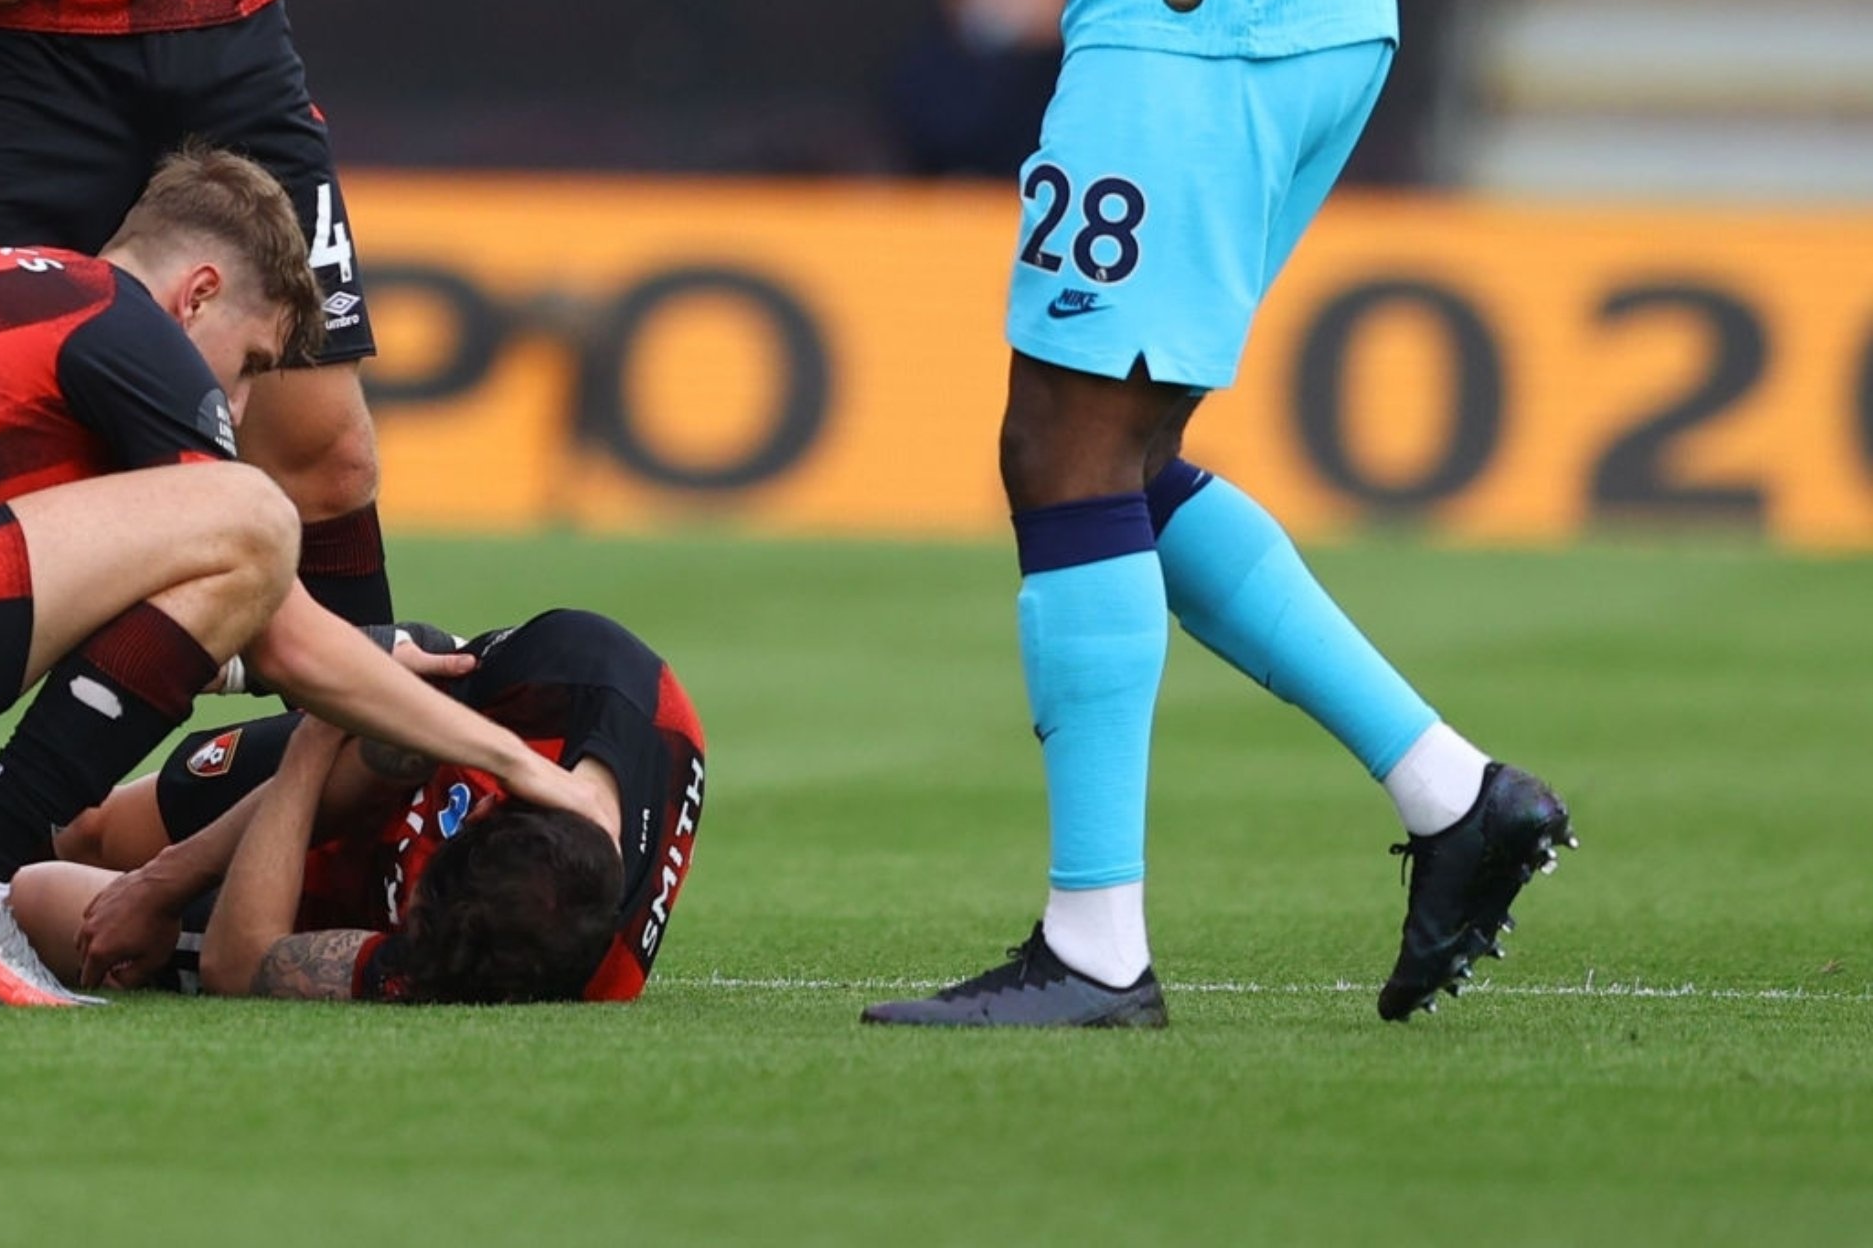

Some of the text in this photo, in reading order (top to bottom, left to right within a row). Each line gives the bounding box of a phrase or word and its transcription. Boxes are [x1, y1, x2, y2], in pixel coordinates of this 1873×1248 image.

[308, 183, 353, 283] 4
[1019, 162, 1147, 285] 28
[325, 314, 360, 330] umbro
[1058, 287, 1099, 307] NIKE
[642, 757, 704, 957] SMITH
